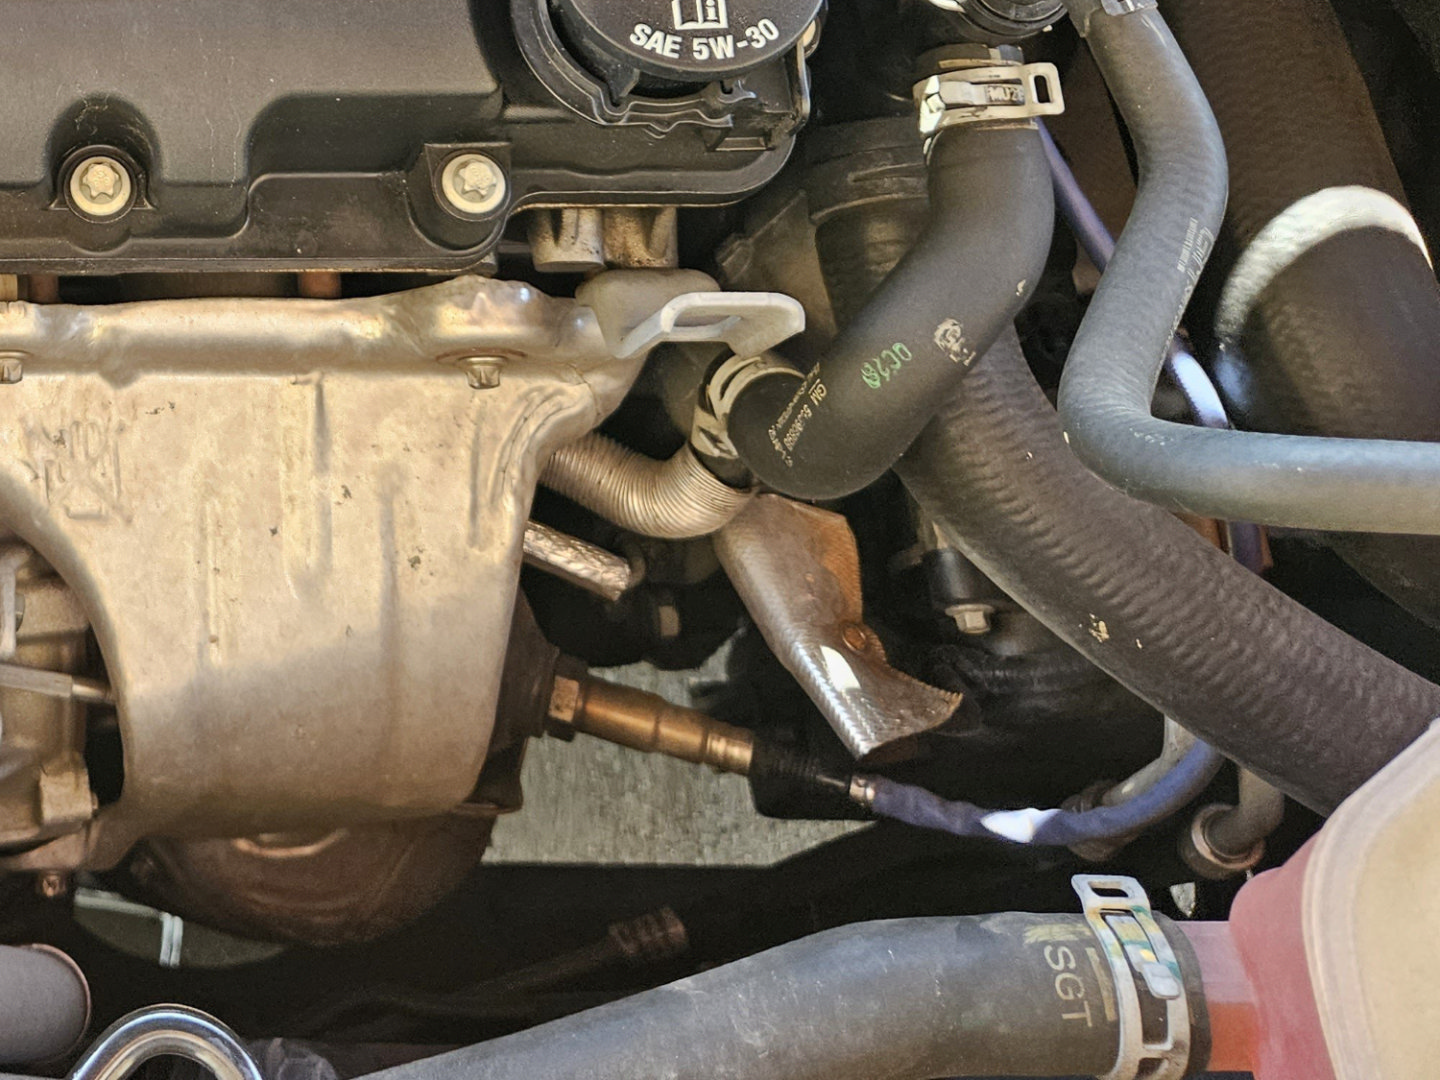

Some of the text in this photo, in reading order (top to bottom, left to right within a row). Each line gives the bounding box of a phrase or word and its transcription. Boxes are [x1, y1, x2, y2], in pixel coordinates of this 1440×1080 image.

[629, 19, 780, 61] SAE 5W-30
[1043, 944, 1094, 1028] SGT
